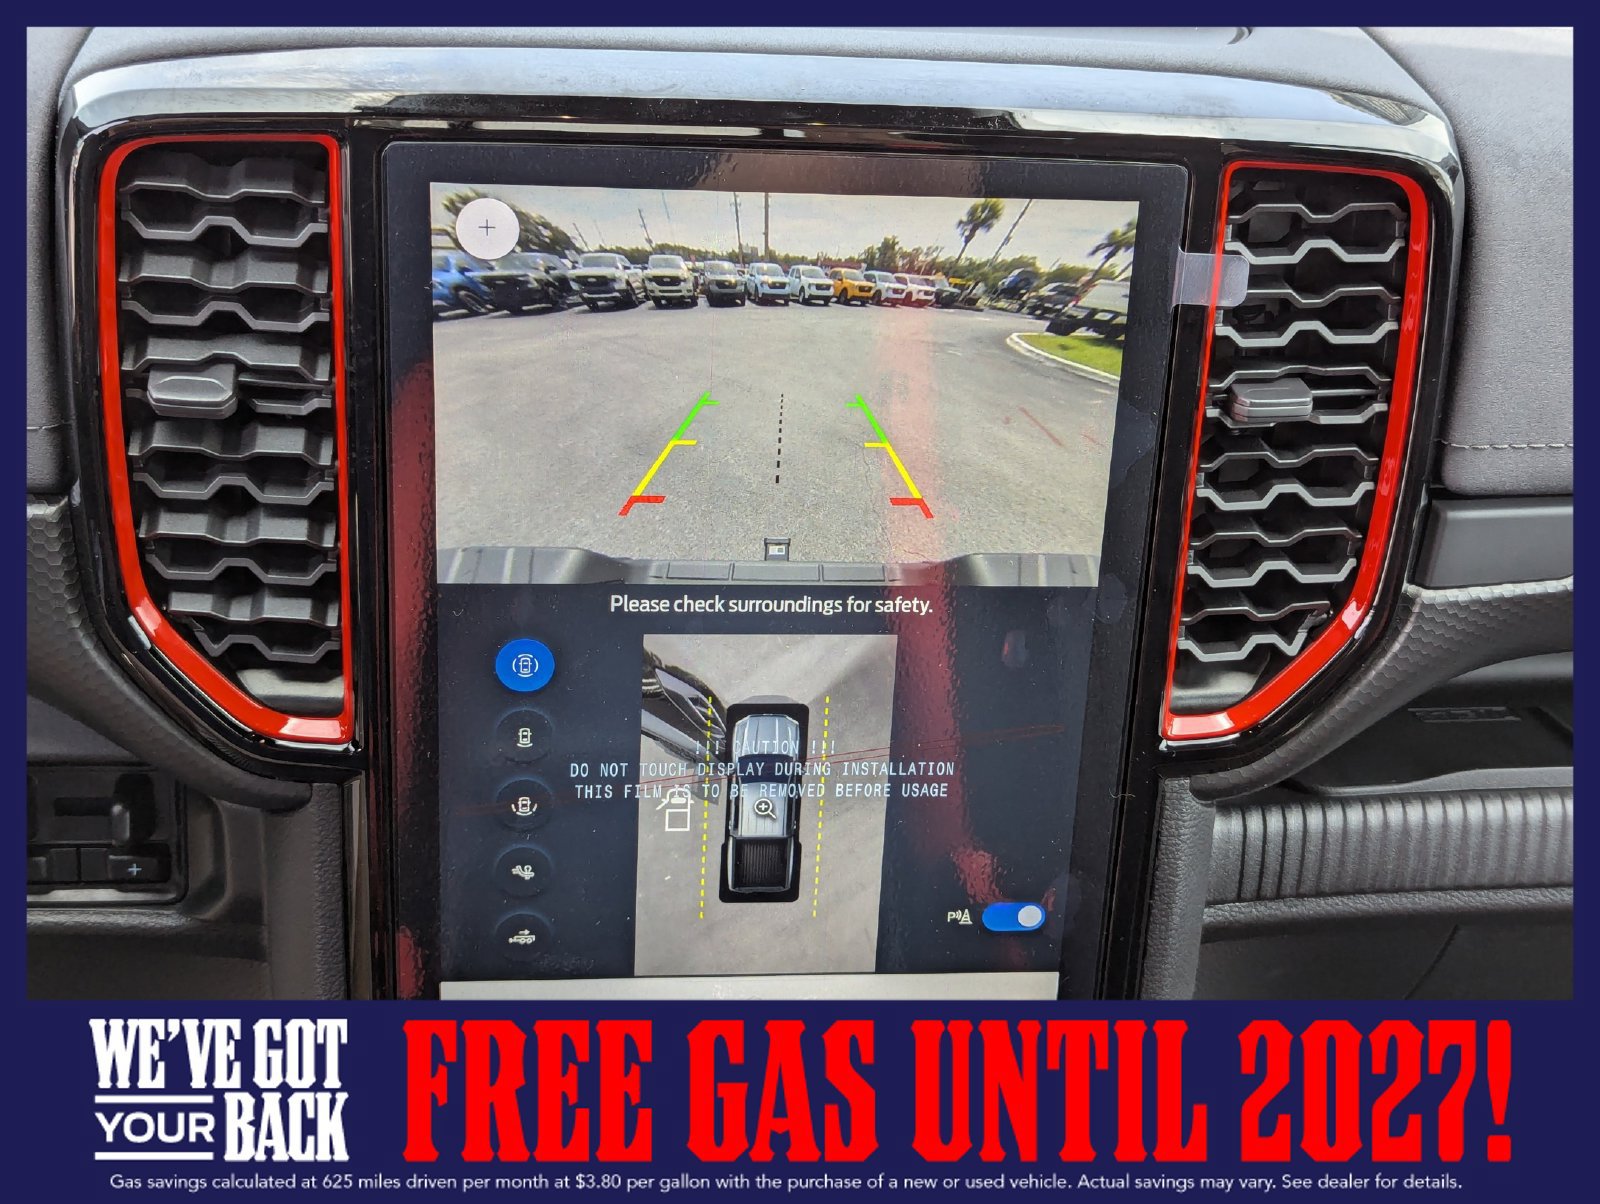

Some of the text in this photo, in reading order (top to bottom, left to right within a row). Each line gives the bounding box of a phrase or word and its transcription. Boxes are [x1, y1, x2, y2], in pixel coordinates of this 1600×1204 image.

[610, 594, 934, 616] Please check surroundings for safety.
[735, 740, 799, 755] CAUTION
[570, 762, 955, 778] DO NOT TOUCH DISPLAY DURING INSTALLATION
[575, 783, 948, 799] THIS FILM IS TO BE REMOVED BEFORE USAGE
